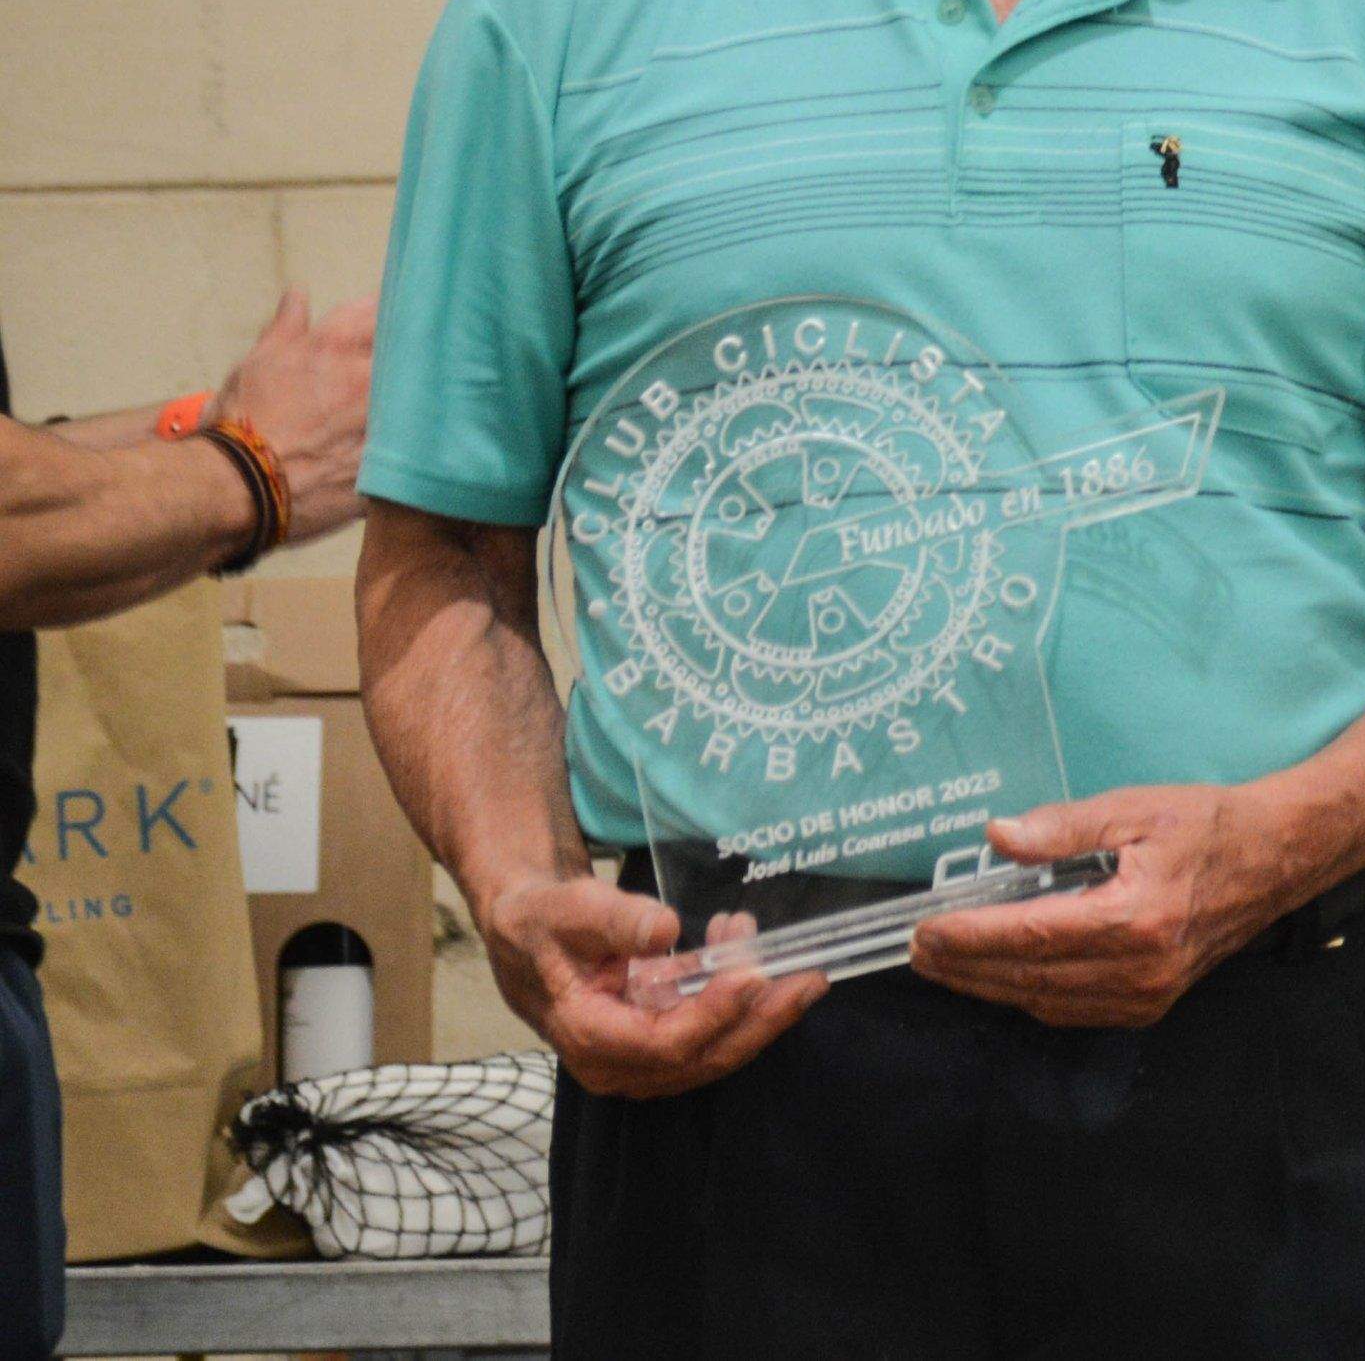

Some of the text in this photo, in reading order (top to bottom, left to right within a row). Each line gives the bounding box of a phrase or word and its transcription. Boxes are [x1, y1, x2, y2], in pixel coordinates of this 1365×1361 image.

[573, 318, 1006, 544] CLUB CICLISTA
[840, 451, 1157, 564] Fundado en 1886
[604, 575, 1039, 782] BARBASTRO
[716, 769, 1001, 859] SOCIO DE HONOR 2023
[33, 893, 133, 926] LING
